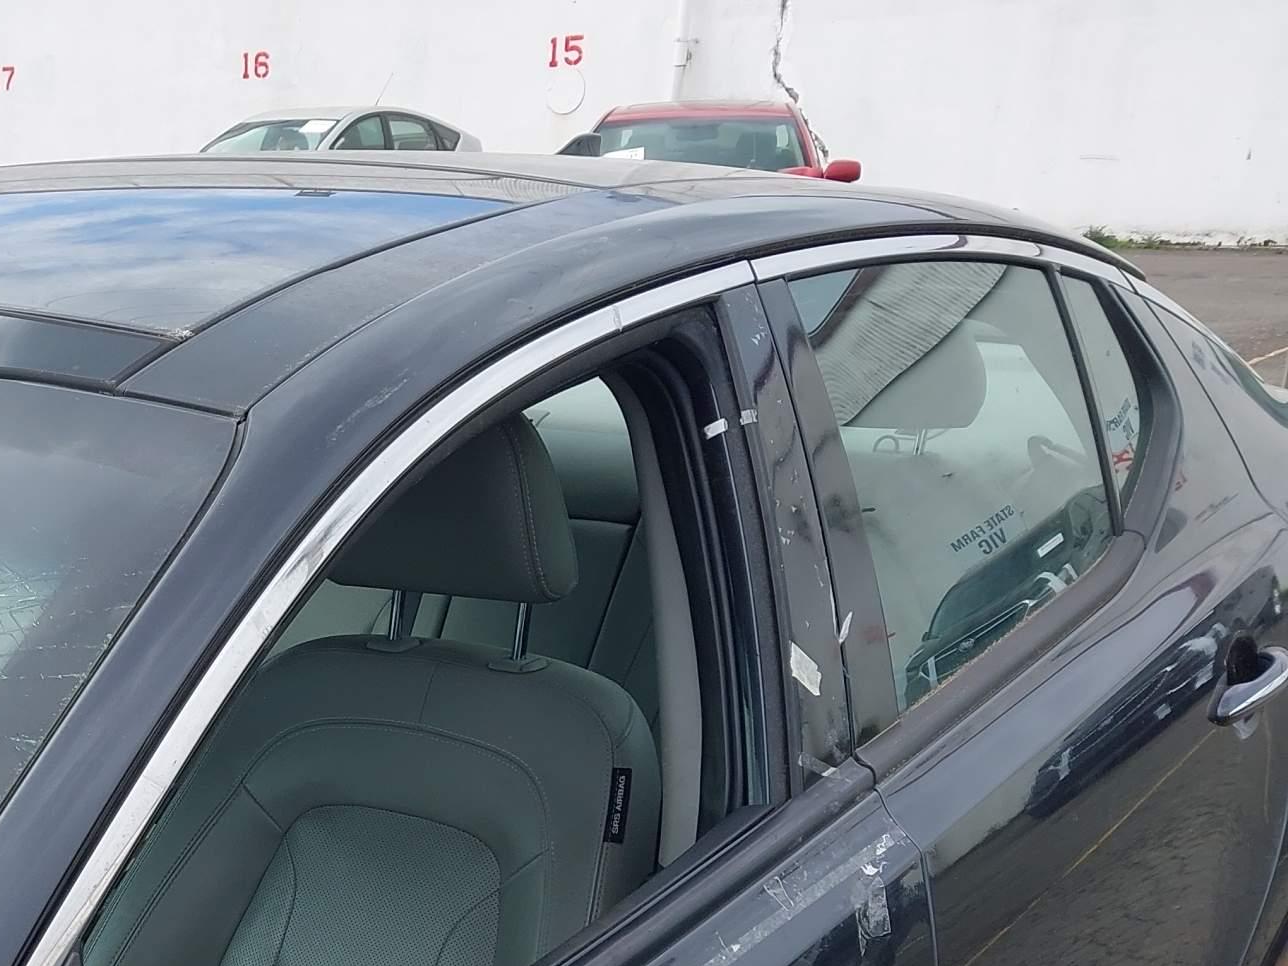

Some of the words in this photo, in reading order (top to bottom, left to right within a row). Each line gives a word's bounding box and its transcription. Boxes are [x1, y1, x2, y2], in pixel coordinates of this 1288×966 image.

[243, 52, 270, 79] 16
[549, 35, 584, 67] 15
[611, 813, 621, 835] SRS
[616, 775, 626, 812] AIRBAG
